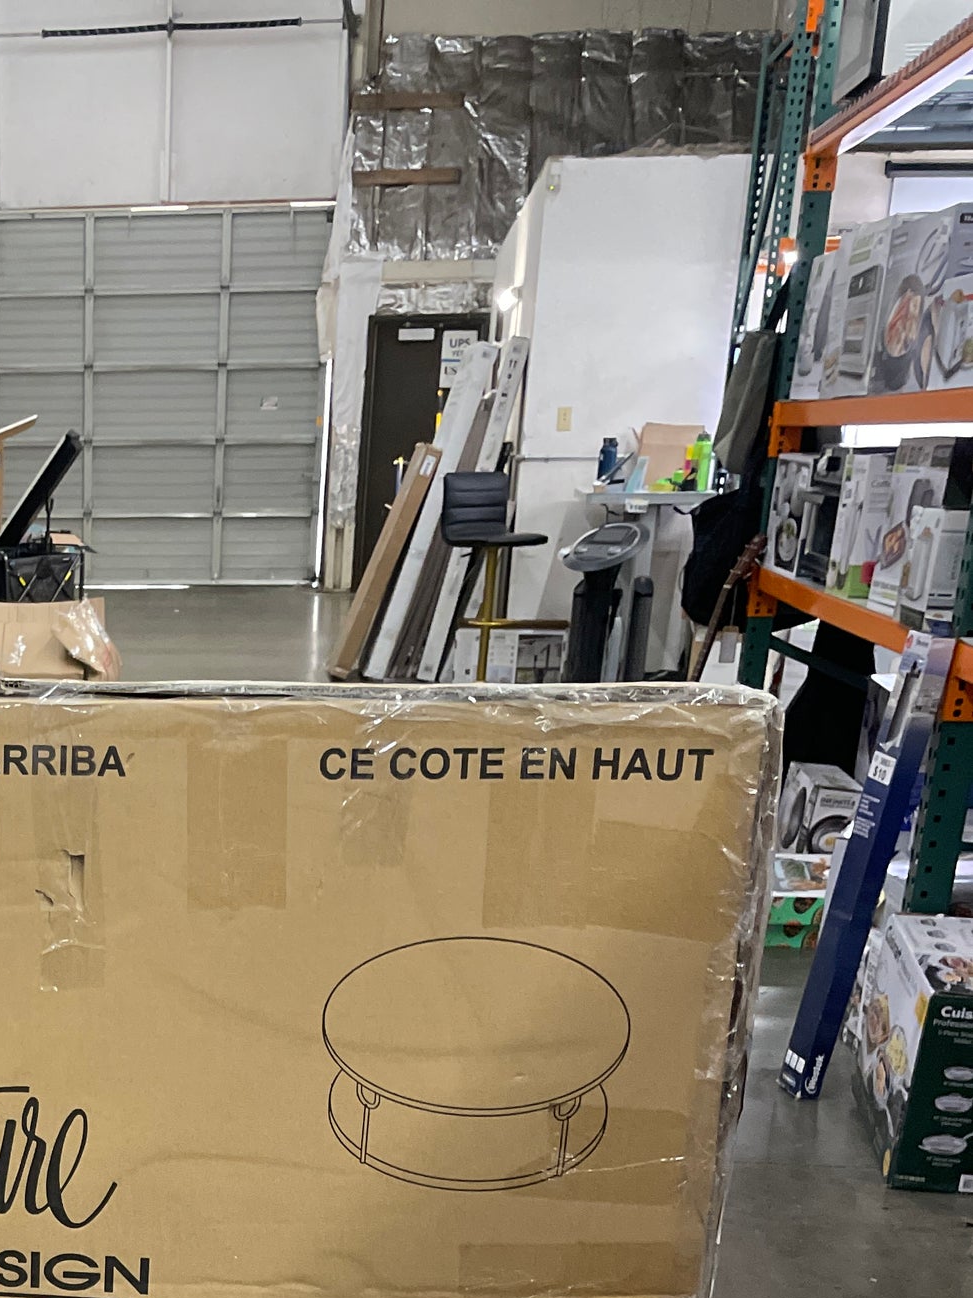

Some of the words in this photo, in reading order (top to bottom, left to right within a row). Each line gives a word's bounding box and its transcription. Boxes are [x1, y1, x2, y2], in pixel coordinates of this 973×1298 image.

[319, 748, 374, 780] CE
[389, 748, 505, 780] COTE
[520, 747, 577, 780] EN
[592, 748, 714, 782] HAUT
